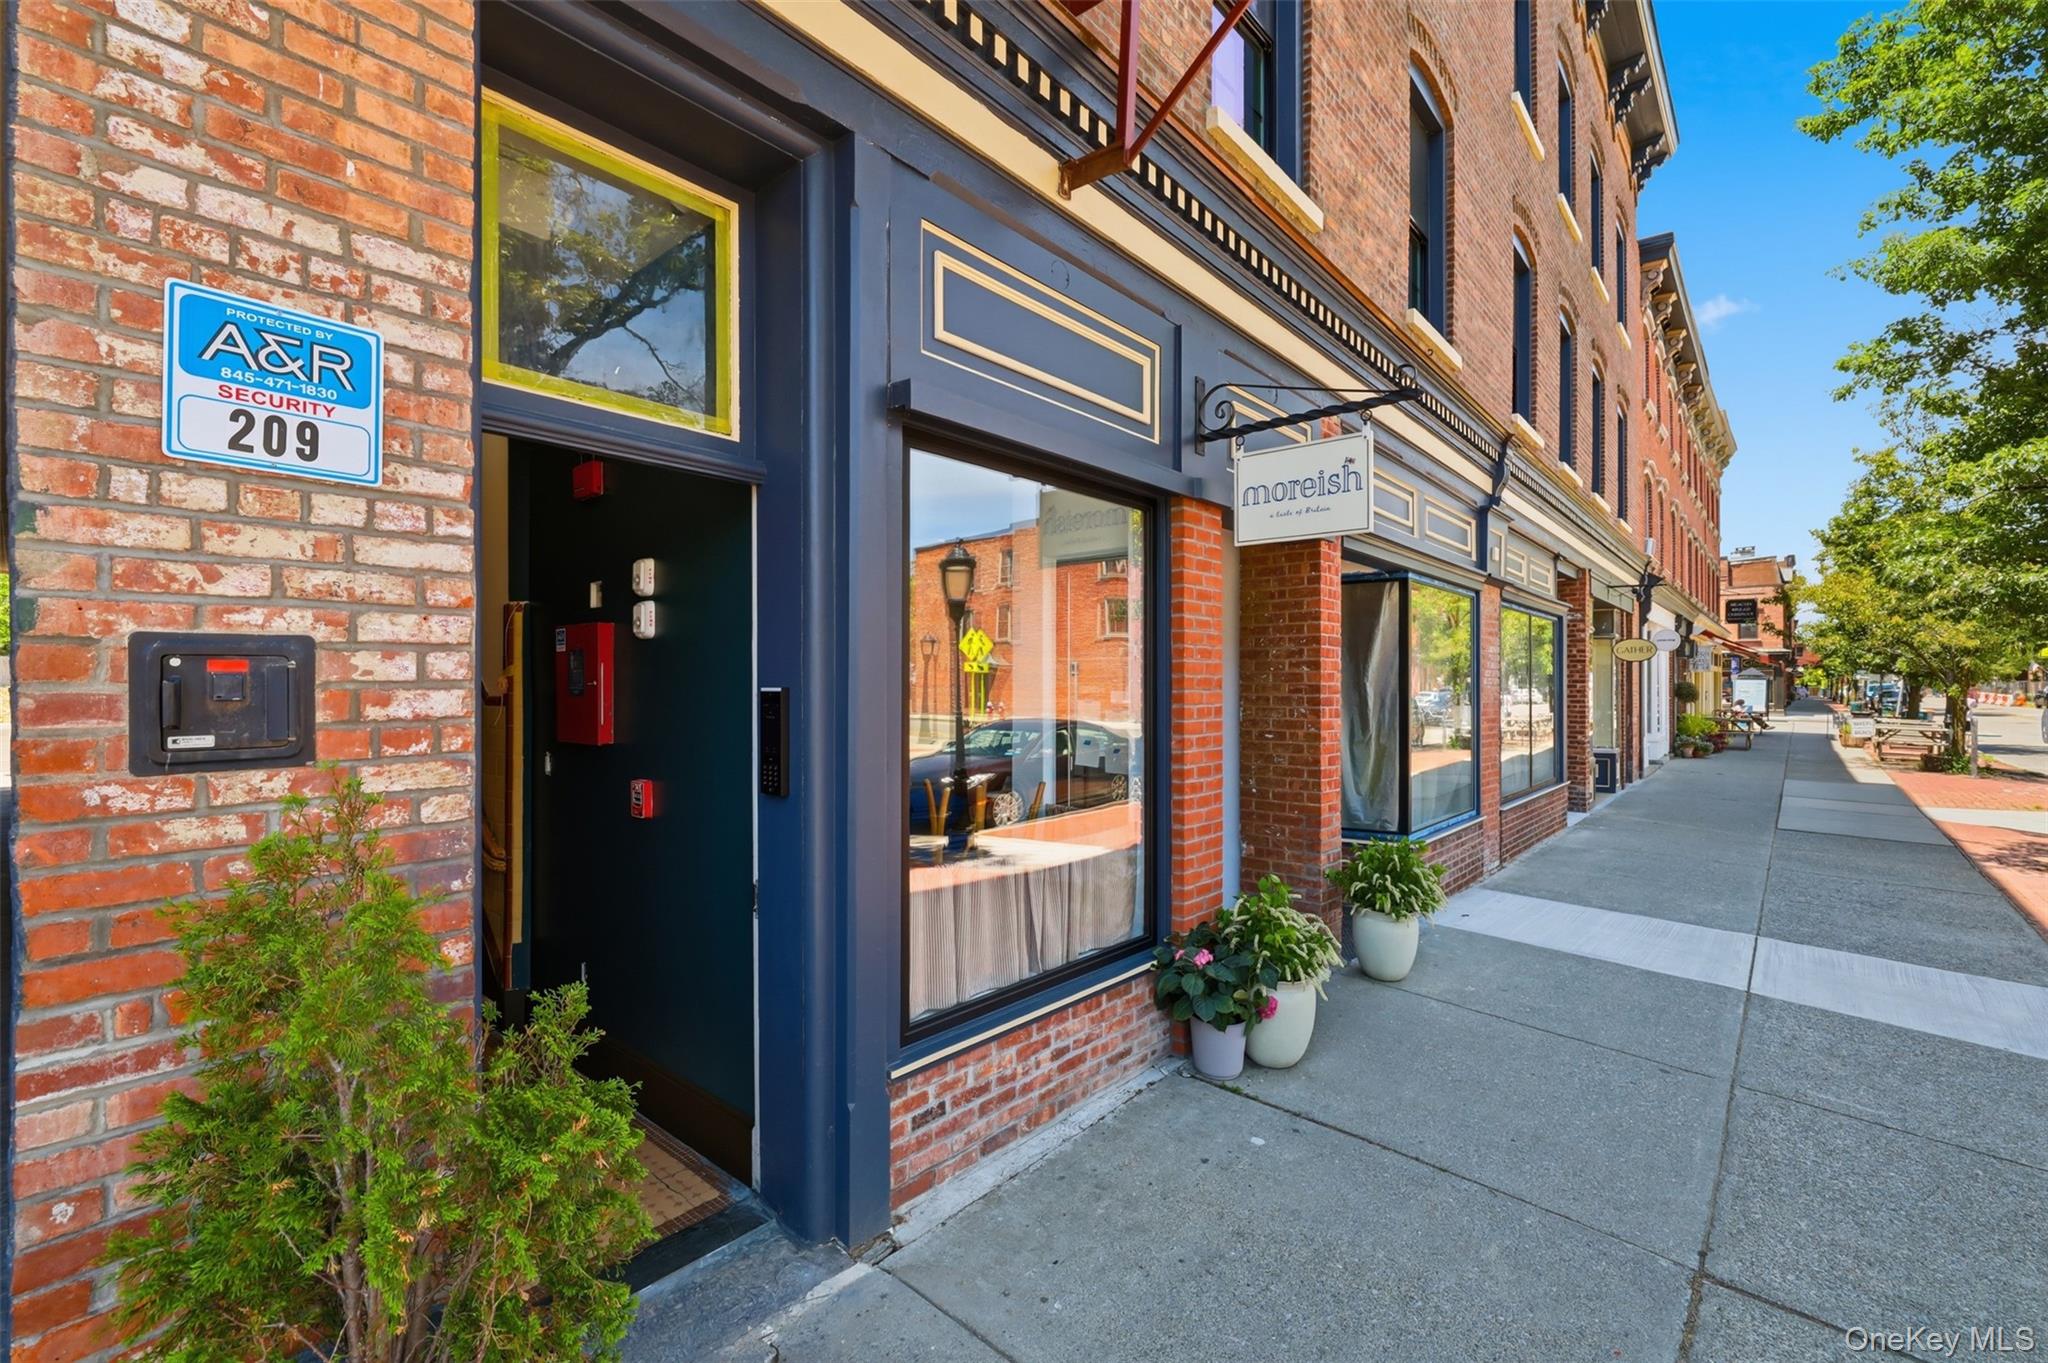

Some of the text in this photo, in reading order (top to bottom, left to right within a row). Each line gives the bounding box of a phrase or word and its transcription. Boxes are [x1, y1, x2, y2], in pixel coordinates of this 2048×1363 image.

[226, 307, 334, 341] PROTECTED BY
[198, 320, 356, 392] A&R
[218, 384, 337, 418] SECURITY
[220, 367, 338, 401] 845-471-1830
[227, 408, 320, 462] 209
[1242, 464, 1363, 507] moreish
[1616, 645, 1654, 654] GATHER
